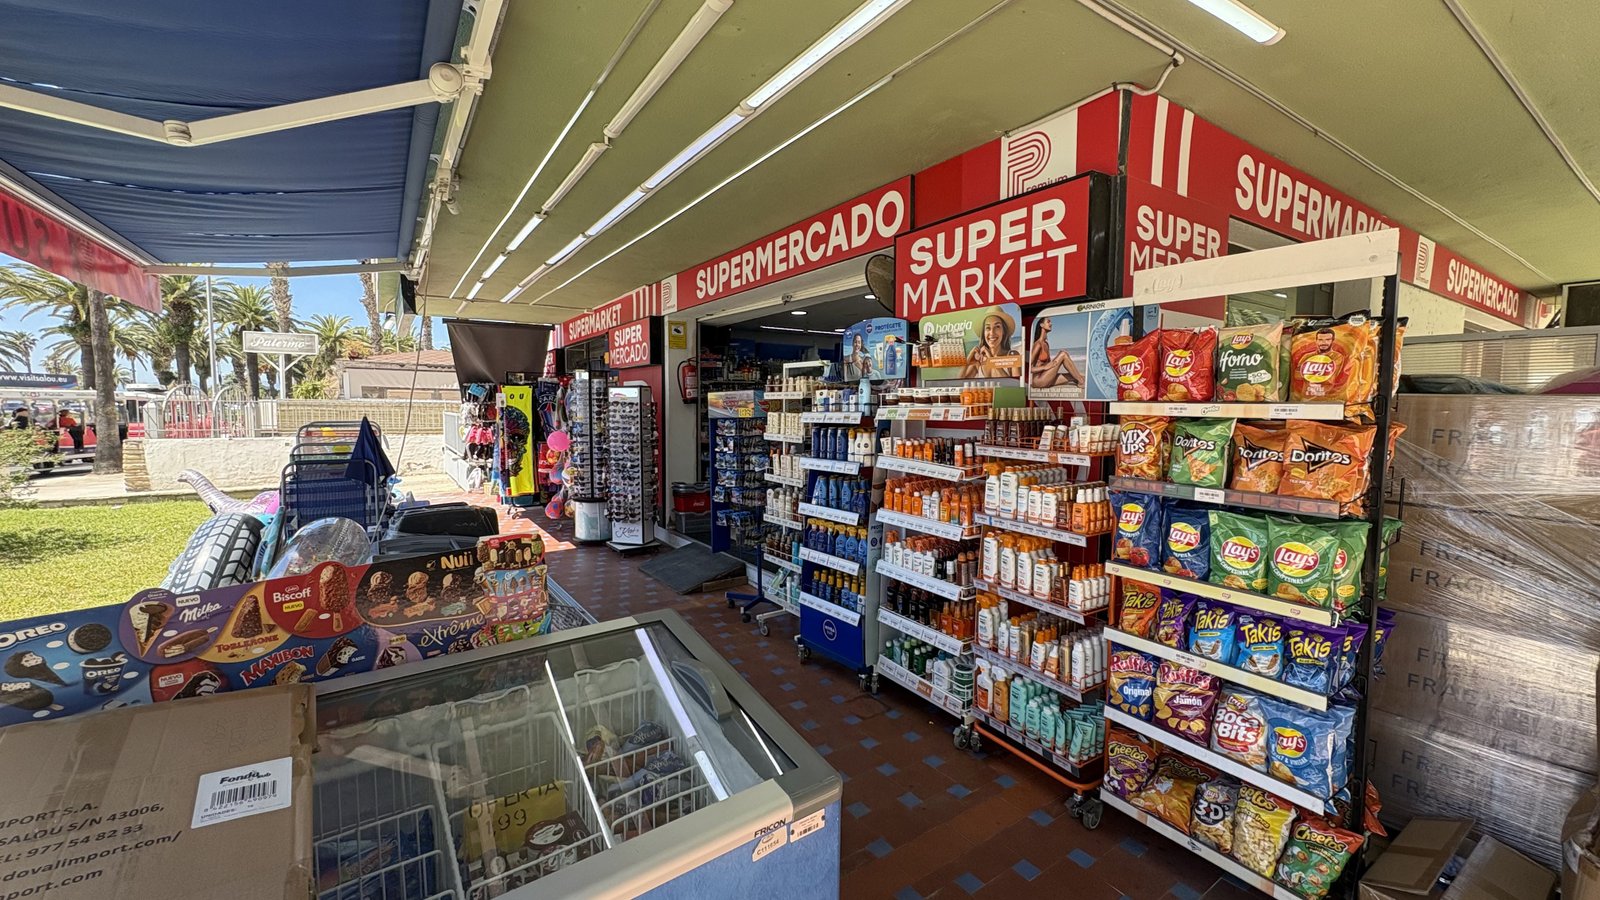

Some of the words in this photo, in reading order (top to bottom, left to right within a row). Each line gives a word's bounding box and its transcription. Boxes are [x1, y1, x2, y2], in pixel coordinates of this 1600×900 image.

[1235, 154, 1392, 240] SUPERMAR
[910, 198, 1067, 275] SUPER
[1136, 205, 1221, 259] SUPER
[696, 190, 905, 300] SUPERMERCADO
[903, 244, 1078, 318] MARKET
[1447, 258, 1520, 319] SUPERMERCADO
[1077, 302, 1106, 312] GARNIER
[568, 303, 622, 341] SUPERMARKET
[250, 336, 305, 349] Palermo
[614, 324, 642, 347] SUPER
[610, 342, 649, 366] MERCADO
[1175, 436, 1216, 451] Doritos
[1292, 449, 1350, 465] Doritos
[178, 596, 200, 607] NUEVO
[273, 586, 312, 604] Biscoff
[1123, 591, 1157, 609] Takis
[178, 603, 223, 624] Milka
[284, 603, 303, 611] NUEVO
[1162, 603, 1185, 620] Takis
[1195, 610, 1230, 633] Takis
[0, 623, 68, 649] OREO
[215, 634, 279, 653] TOBLERONE
[1240, 623, 1282, 647] Takis
[1288, 636, 1332, 658] Takis
[85, 667, 121, 678] OREO
[240, 645, 314, 686] MAXIBON
[1111, 655, 1154, 675] Ruffles
[159, 674, 182, 683] NUEVO
[1160, 662, 1212, 690] Ruffles
[1123, 686, 1152, 698] Original
[1174, 695, 1203, 706] Jamón
[1108, 742, 1148, 762] Cheetos
[219, 771, 260, 785] Fonda
[62, 803, 99, 816] S.A.
[0, 825, 63, 847] SALOU
[68, 817, 103, 832] S/N
[106, 803, 165, 822] 43006,
[754, 818, 787, 838] FRICON
[26, 843, 66, 859] 977
[67, 837, 91, 849] 54
[95, 829, 118, 842] 82
[122, 823, 144, 836] 33
[1296, 825, 1348, 854] Cheetos
[0, 830, 183, 882] dovalimport.com/
